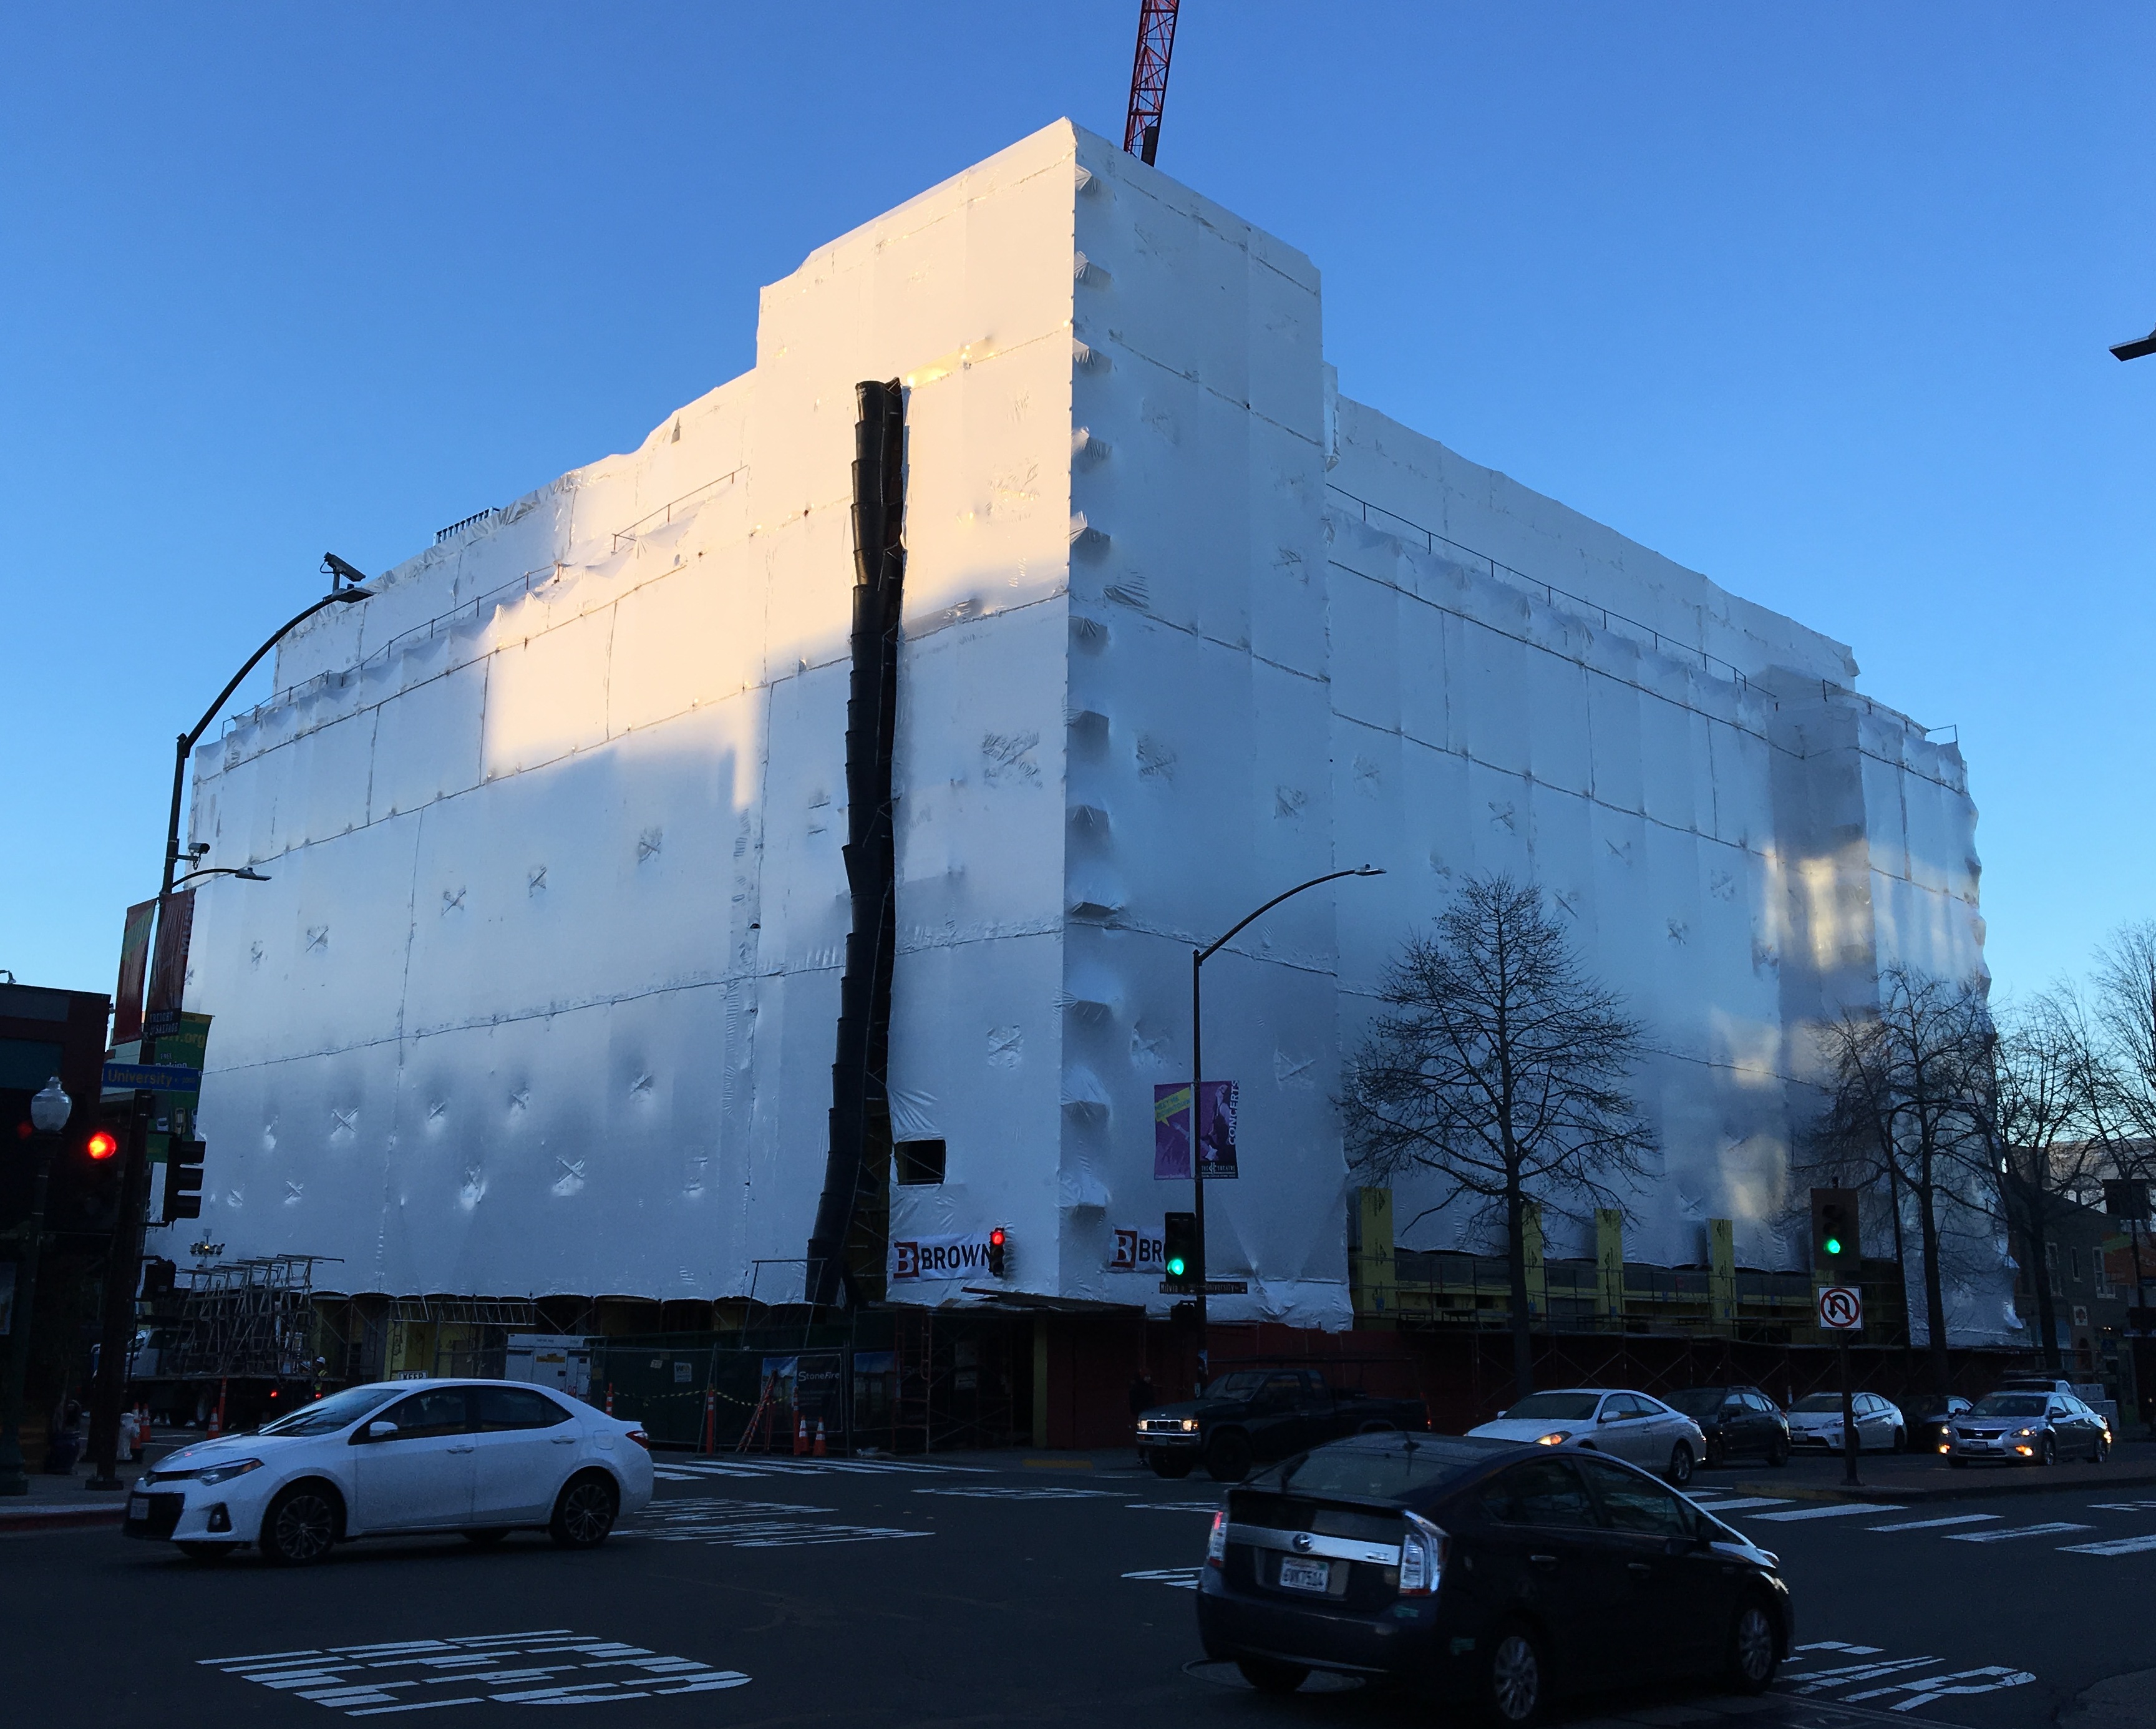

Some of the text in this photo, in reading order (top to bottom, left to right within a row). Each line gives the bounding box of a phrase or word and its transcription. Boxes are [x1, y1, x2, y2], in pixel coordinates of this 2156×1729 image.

[108, 1068, 172, 1087] University
[1228, 1080, 1239, 1145] CONCERTS
[921, 1244, 991, 1270] BROWN
[1139, 1239, 1166, 1262] BR
